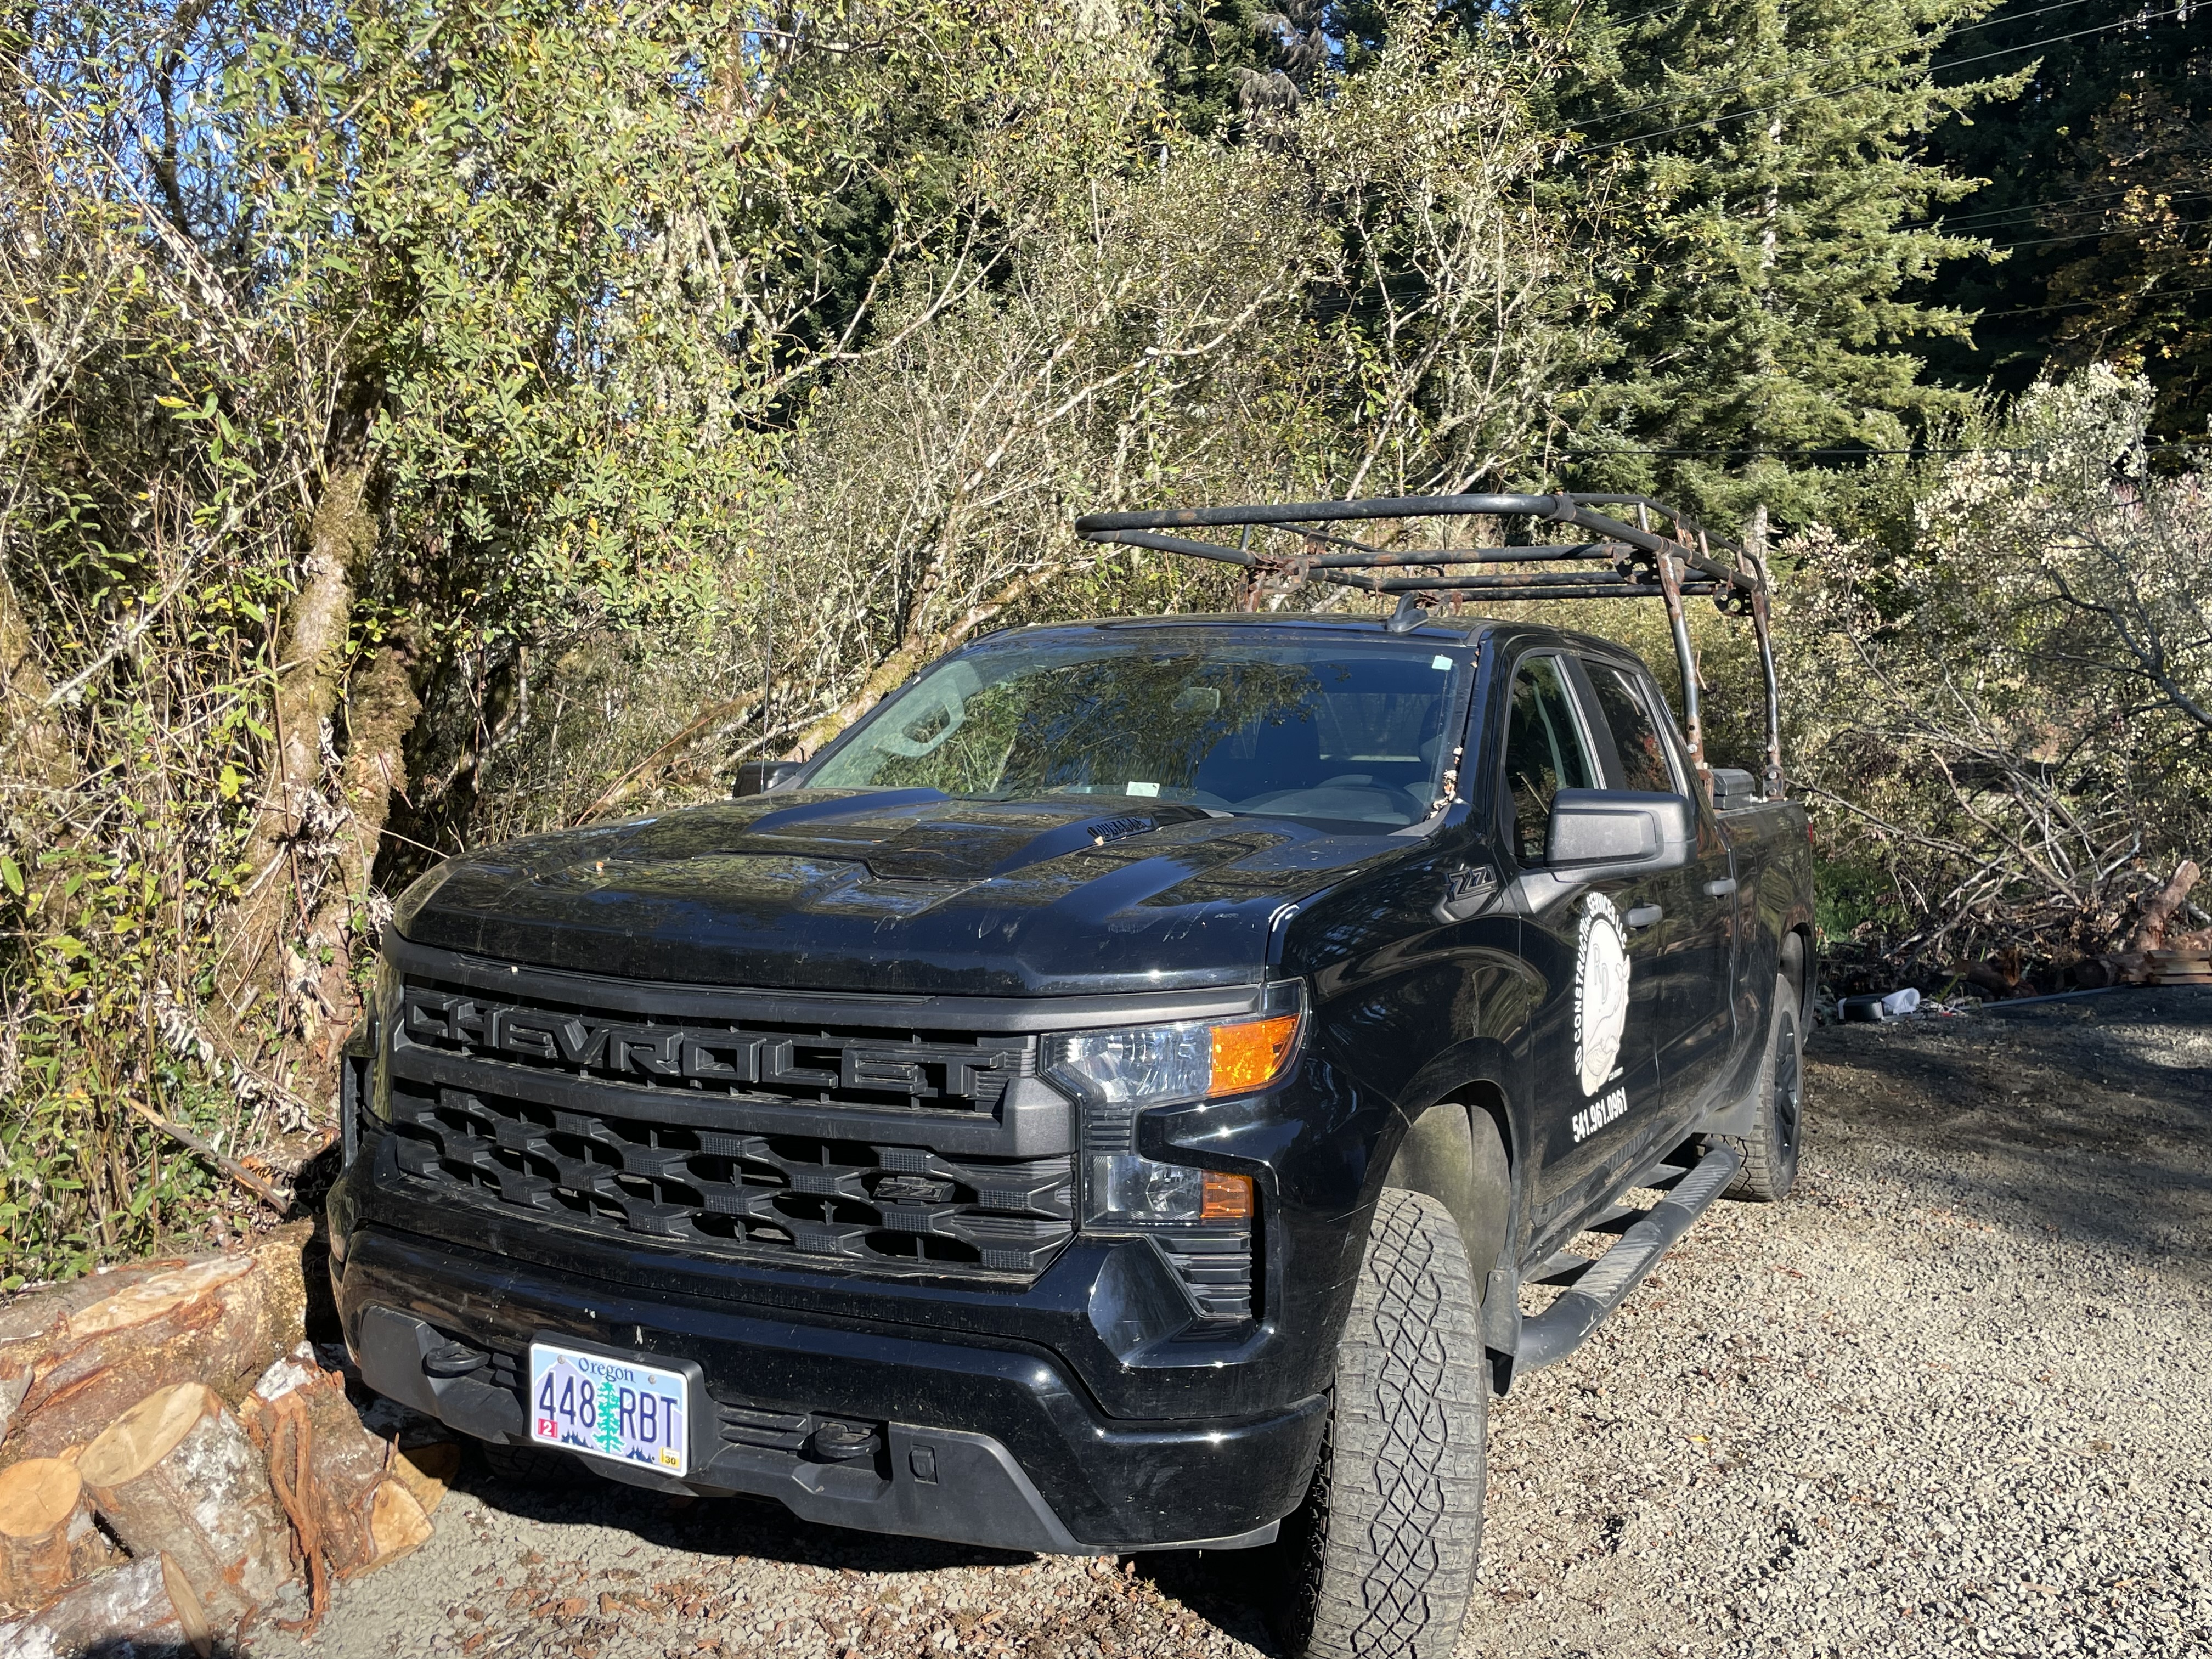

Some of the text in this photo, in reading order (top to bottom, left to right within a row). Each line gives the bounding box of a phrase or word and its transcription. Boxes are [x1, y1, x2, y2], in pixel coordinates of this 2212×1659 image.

[1586, 891, 1616, 926] SERVICES
[1616, 915, 1628, 950] LLC
[405, 990, 1006, 1097] CHEVROLET
[1572, 1086, 1628, 1143] 541.961.0961
[578, 1357, 636, 1383] Oregon
[539, 1372, 678, 1448] 448 RBT
[543, 1421, 552, 1436] 2
[665, 1455, 676, 1465] 30
